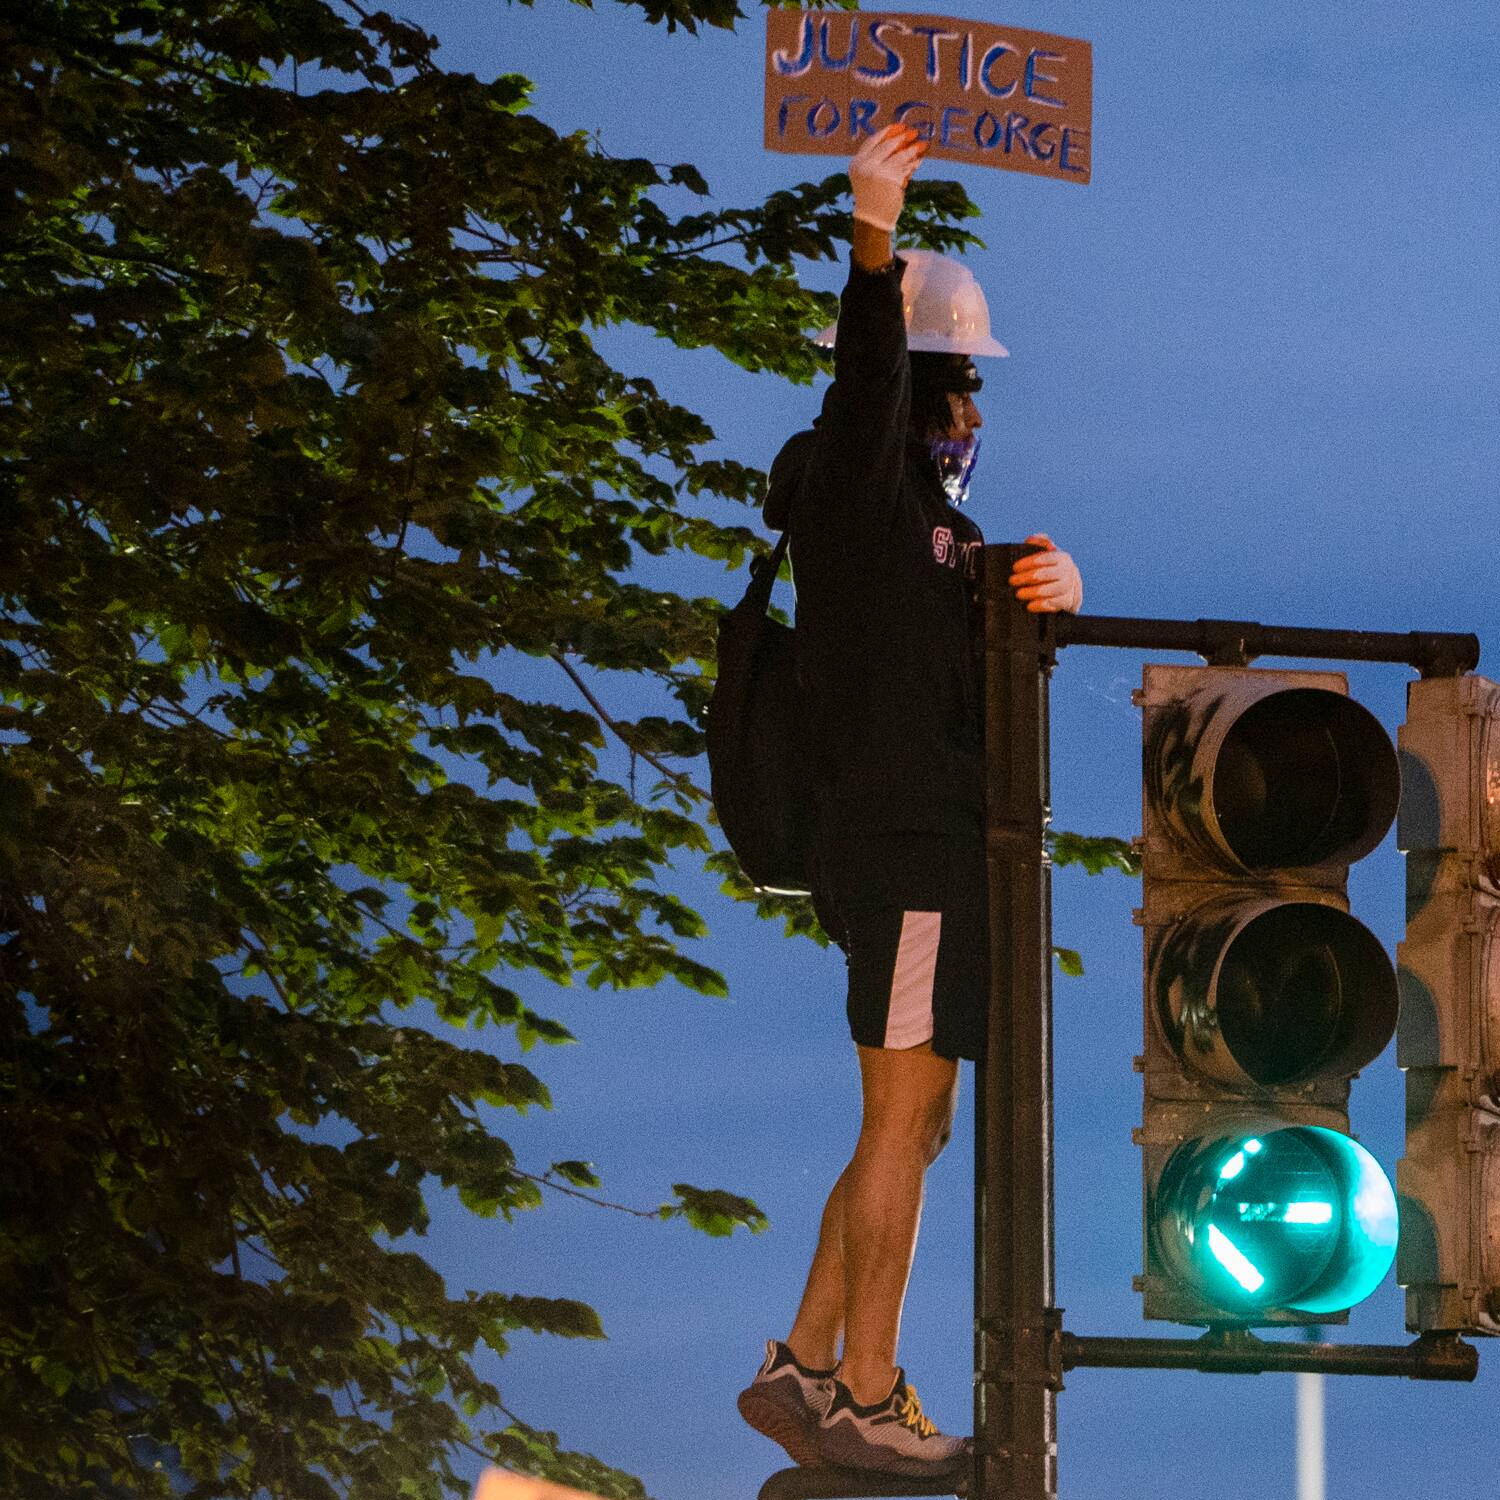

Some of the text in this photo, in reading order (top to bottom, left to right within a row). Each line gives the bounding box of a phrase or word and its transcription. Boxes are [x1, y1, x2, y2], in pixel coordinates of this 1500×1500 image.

[772, 15, 1067, 108] JUSTICE
[778, 95, 1090, 173] FOR GEORGE
